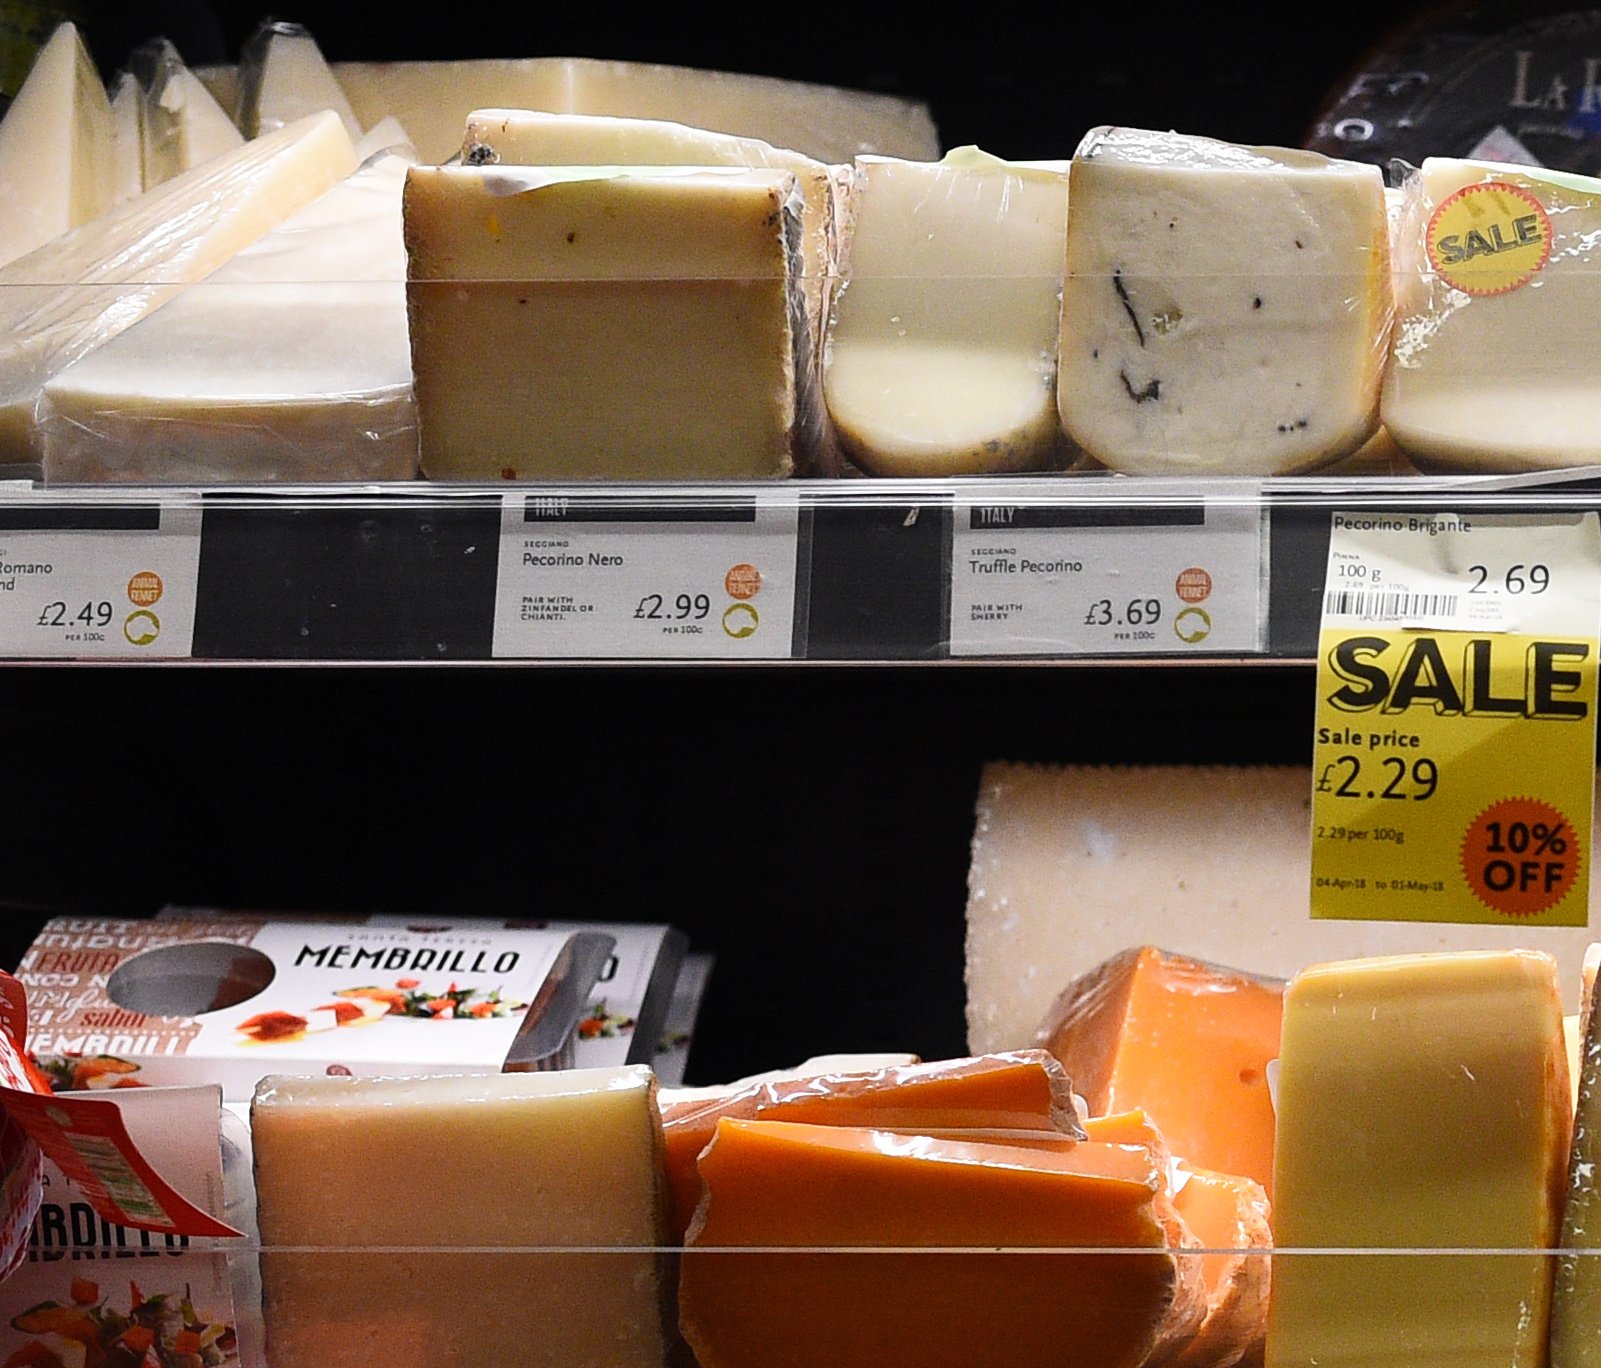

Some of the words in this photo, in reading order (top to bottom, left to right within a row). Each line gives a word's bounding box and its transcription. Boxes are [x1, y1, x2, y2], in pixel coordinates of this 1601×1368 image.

[1435, 213, 1543, 265] SALE
[1334, 516, 1401, 531] Pecorino
[1408, 517, 1472, 536] Brigante
[522, 552, 584, 566] Pecorino
[588, 552, 624, 566] Nero
[969, 559, 1016, 574] Truffle
[1021, 559, 1082, 573] Pecorino
[1467, 564, 1550, 595] 2.69
[36, 601, 113, 627] £2.49
[633, 593, 710, 619] £2.99
[1083, 599, 1161, 626] £3.69
[1327, 636, 1590, 721] SALE
[1318, 728, 1362, 745] Sale
[1369, 730, 1420, 751] price
[1484, 822, 1568, 855] 10%
